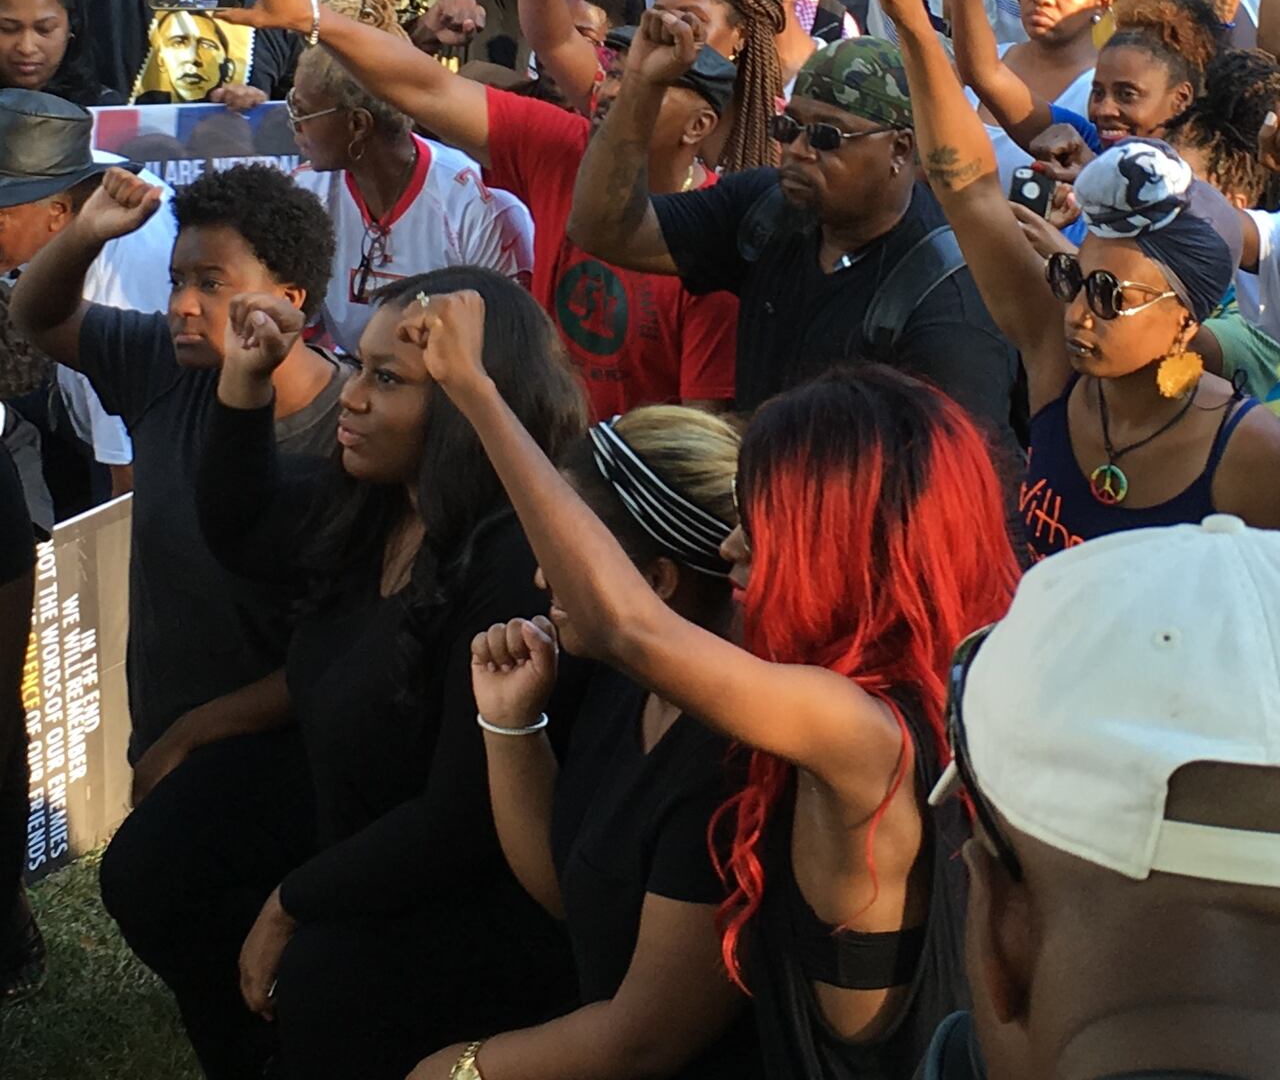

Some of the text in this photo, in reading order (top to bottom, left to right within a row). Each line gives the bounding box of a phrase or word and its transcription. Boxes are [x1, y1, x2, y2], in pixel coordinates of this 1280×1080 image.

[26, 710, 42, 736] OF
[36, 538, 69, 859] NOT THE WORDS OF OUR ENEMIES
[62, 593, 88, 784] WE WILL REMEMBER
[81, 628, 101, 733] IN THE END
[27, 741, 44, 784] OUR
[27, 787, 47, 871] FRIENDS
